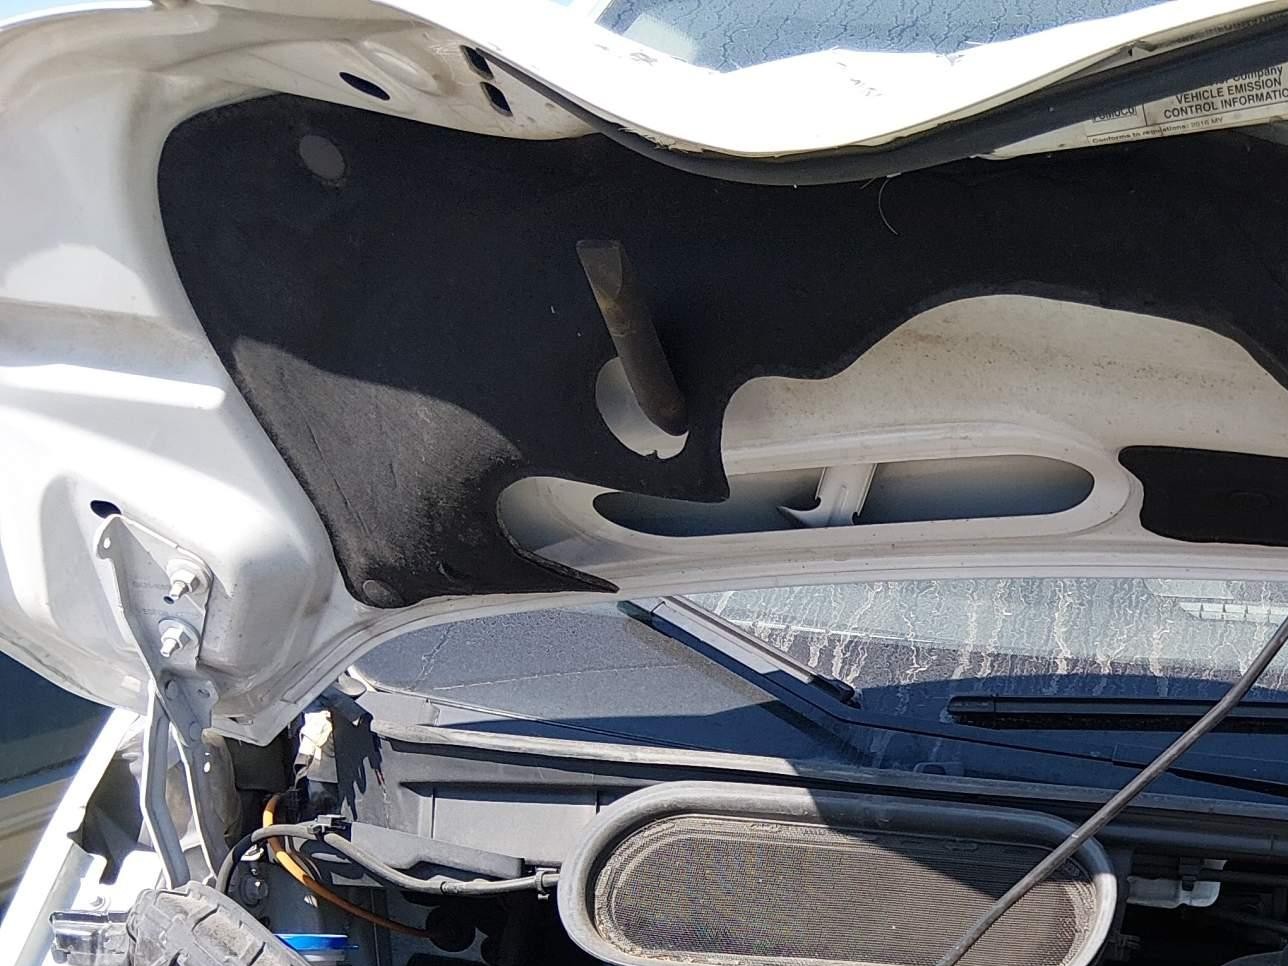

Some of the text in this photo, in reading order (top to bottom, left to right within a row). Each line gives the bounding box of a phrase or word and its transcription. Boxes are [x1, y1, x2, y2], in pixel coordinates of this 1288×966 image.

[1176, 77, 1282, 104] VEHICLE EMISSION
[1164, 101, 1218, 118] CONTROL
[1092, 133, 1131, 143] Conforms
[1190, 118, 1209, 127] 2016
